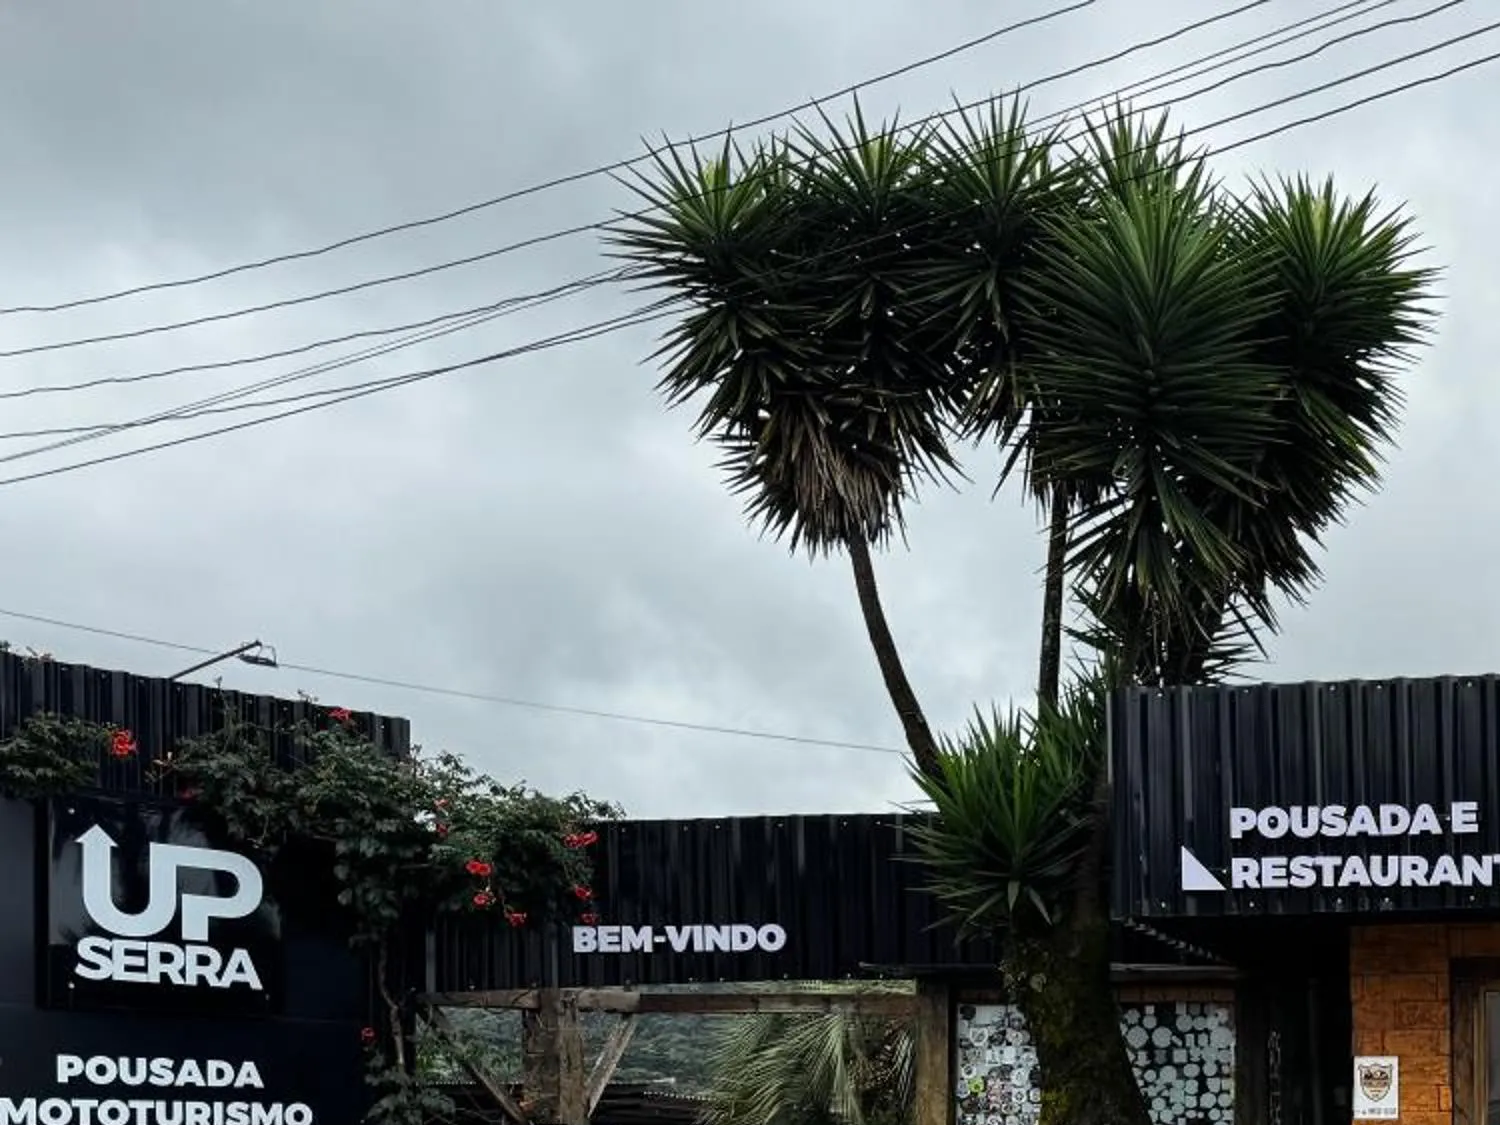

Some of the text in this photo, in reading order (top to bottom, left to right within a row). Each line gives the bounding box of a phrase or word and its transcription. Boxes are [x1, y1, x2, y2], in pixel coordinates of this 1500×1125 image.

[1229, 802, 1479, 838] POUSADA E
[76, 824, 262, 942] UP
[573, 924, 787, 953] BEM-VINDO
[75, 936, 263, 990] SERRA
[57, 1055, 264, 1088] POUSADA
